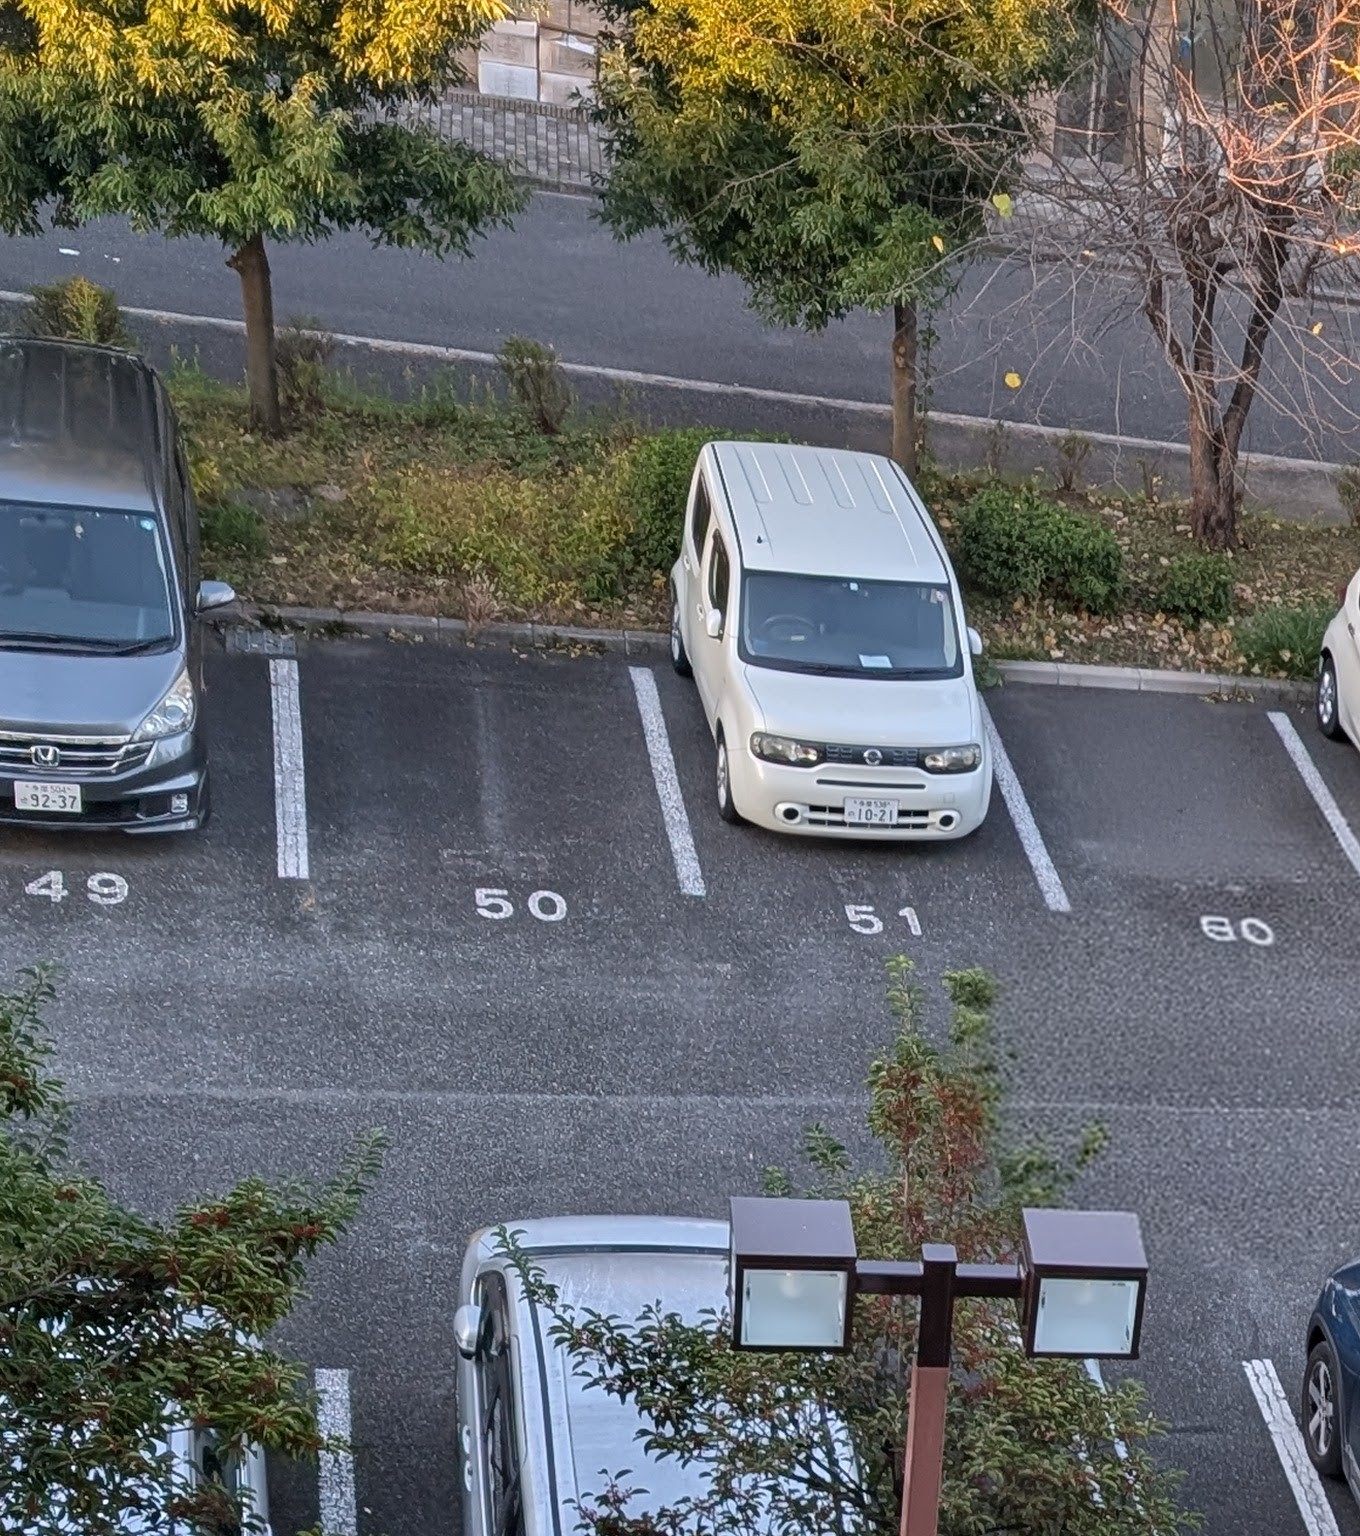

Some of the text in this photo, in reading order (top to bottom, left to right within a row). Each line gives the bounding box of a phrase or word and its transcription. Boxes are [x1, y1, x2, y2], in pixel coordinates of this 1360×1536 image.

[30, 794, 77, 809] 92-37
[858, 808, 893, 822] 10-21
[25, 870, 129, 906] 49
[475, 887, 568, 921] 50
[845, 904, 922, 936] 51
